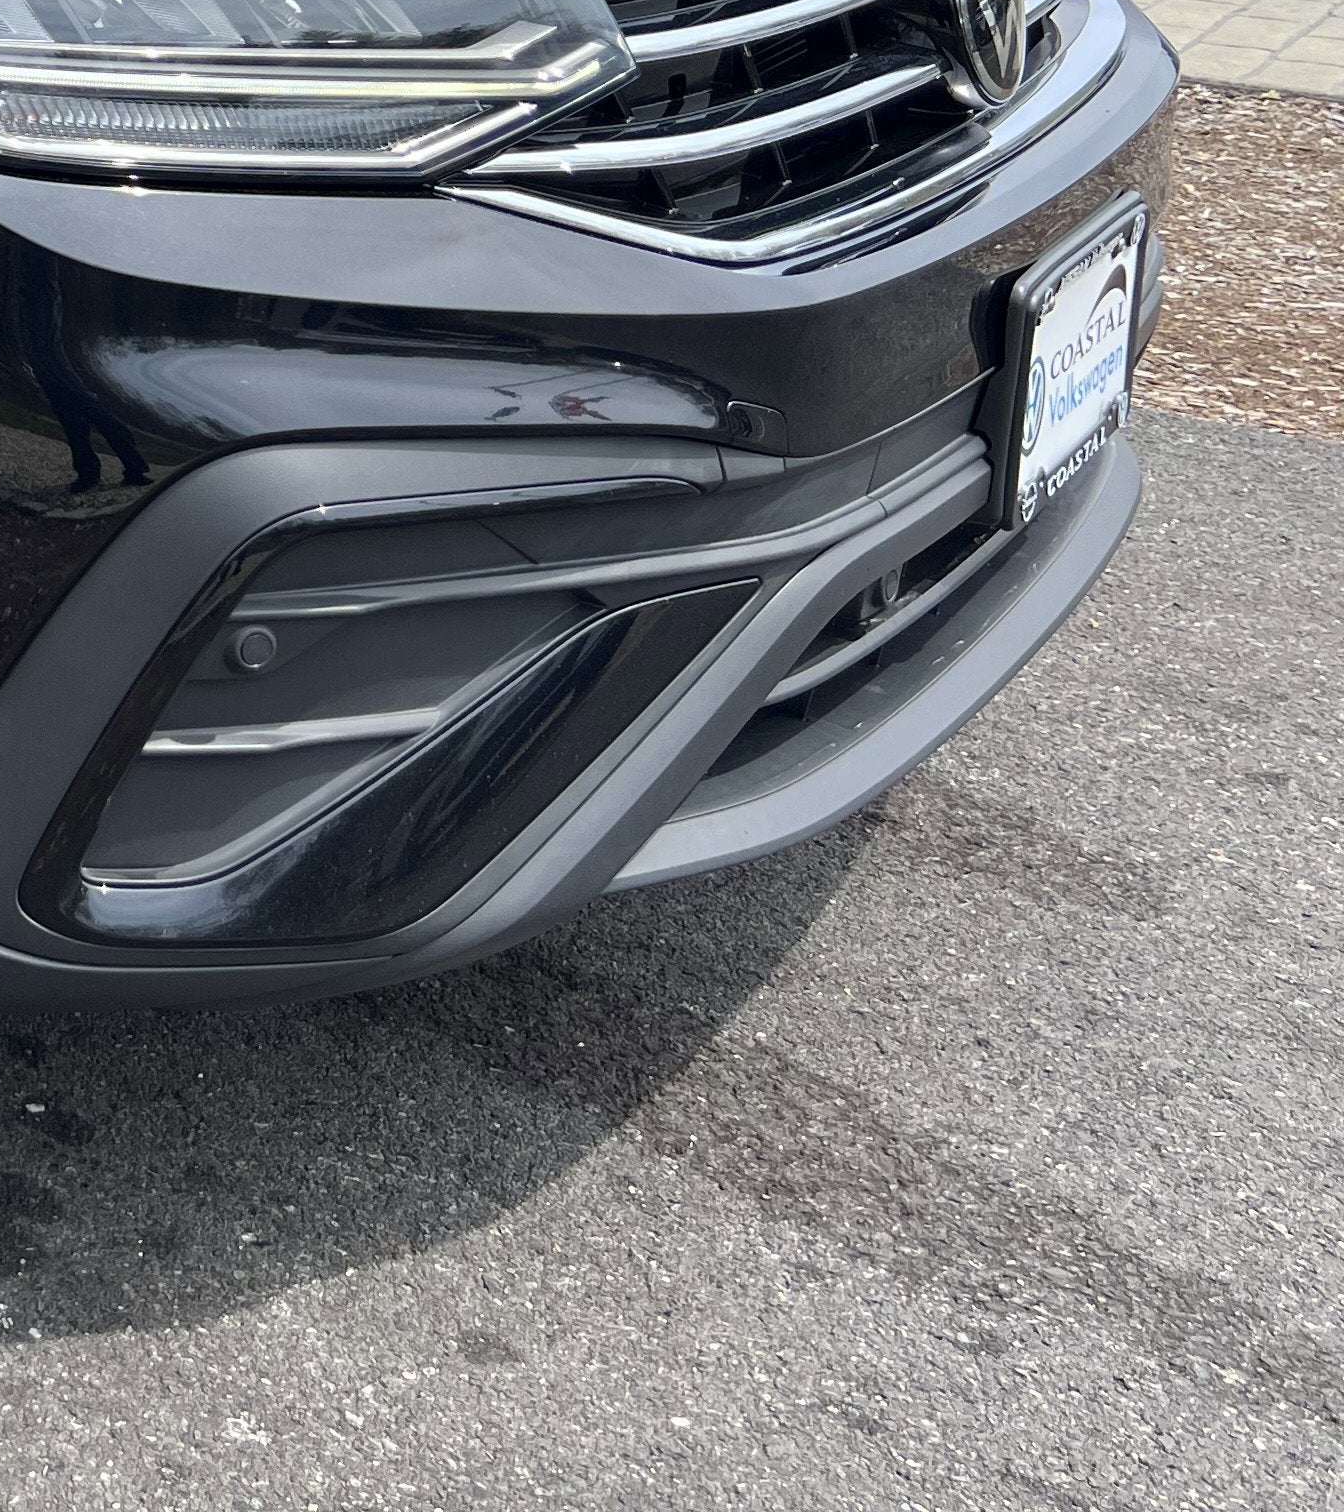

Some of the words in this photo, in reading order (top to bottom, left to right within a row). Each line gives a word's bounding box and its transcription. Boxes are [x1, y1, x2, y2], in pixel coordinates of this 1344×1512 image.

[1050, 299, 1127, 380] COASTAL
[1048, 343, 1124, 426] Volkswagen
[1046, 425, 1108, 498] COASTAL
